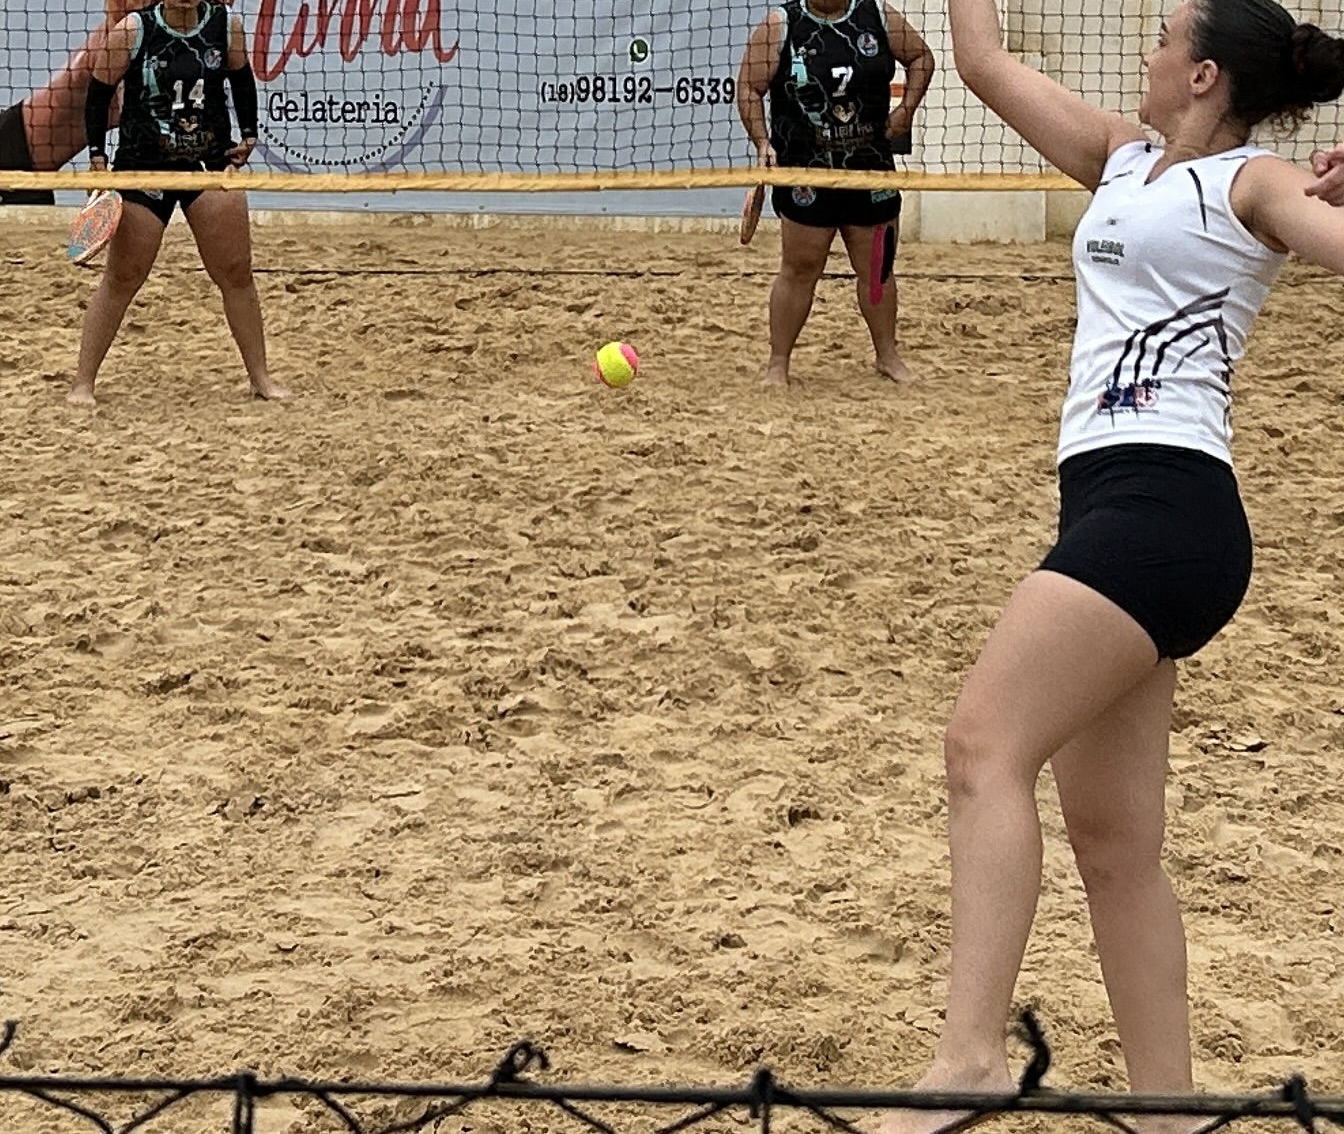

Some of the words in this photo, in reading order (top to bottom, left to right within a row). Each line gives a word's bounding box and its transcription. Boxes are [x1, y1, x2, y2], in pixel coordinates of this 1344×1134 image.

[171, 78, 206, 110] 14
[830, 65, 854, 98] 7
[268, 91, 400, 124] Gelateria
